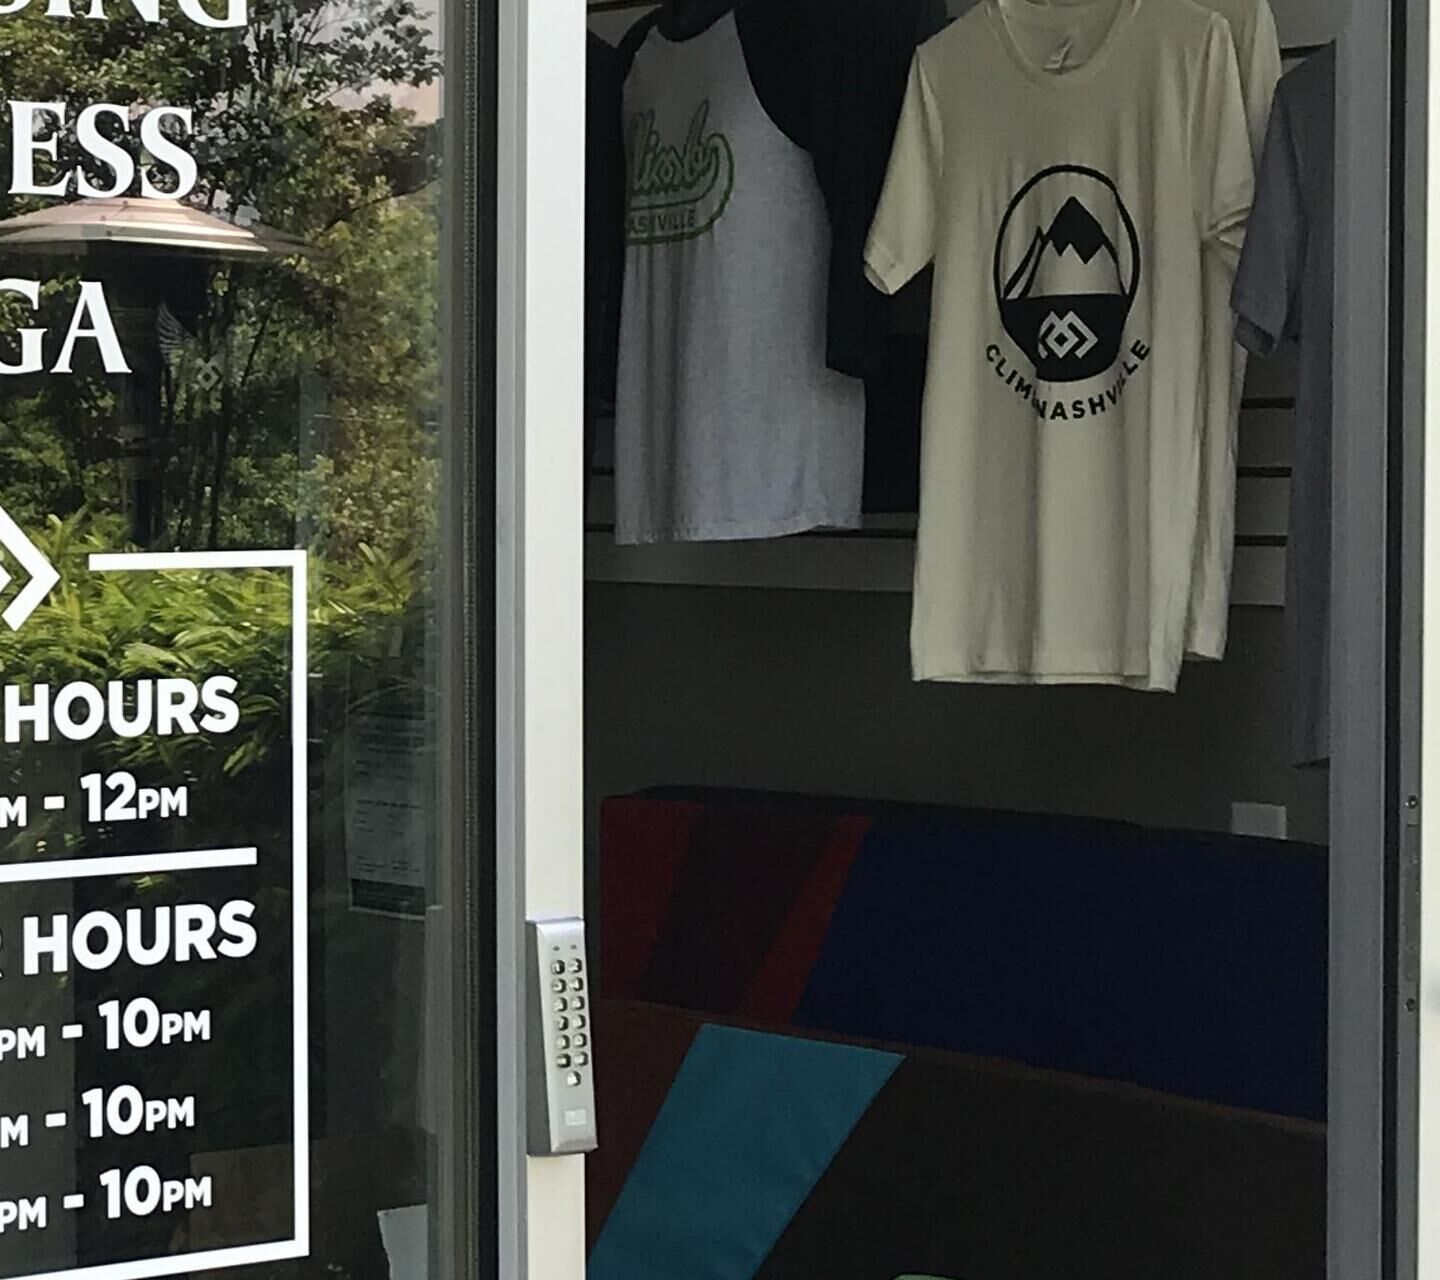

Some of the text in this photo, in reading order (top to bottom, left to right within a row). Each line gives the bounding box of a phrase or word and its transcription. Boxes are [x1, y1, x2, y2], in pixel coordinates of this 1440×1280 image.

[4, 675, 241, 743] HOURS
[80, 771, 187, 822] 12PM
[23, 900, 257, 975] HOURS
[98, 997, 210, 1050] 10PM
[82, 1085, 194, 1138] 10PM
[99, 1165, 212, 1219] 10PM
